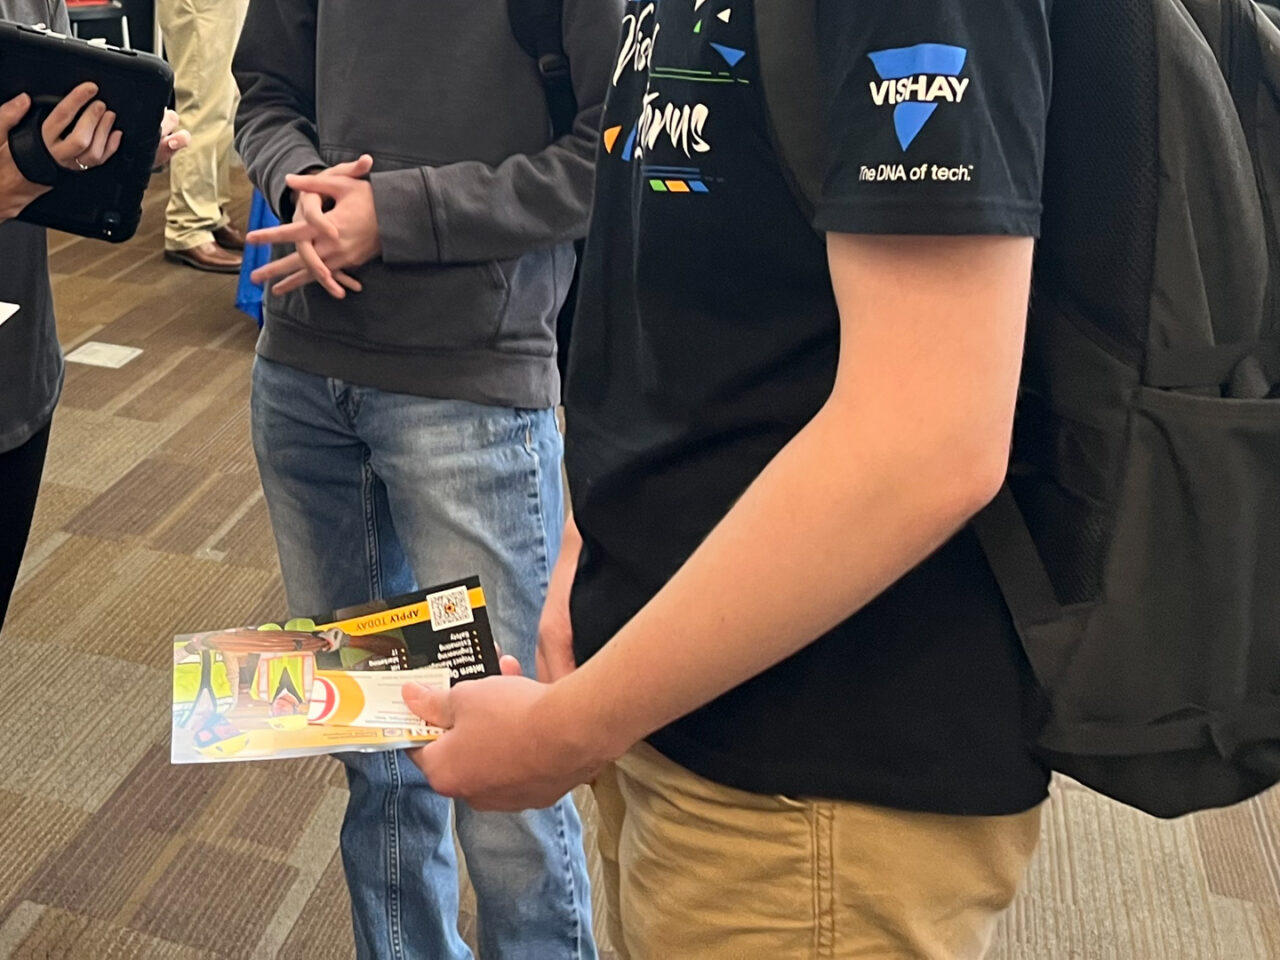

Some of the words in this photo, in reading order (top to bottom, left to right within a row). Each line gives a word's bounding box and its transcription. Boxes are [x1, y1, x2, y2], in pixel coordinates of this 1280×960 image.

[869, 75, 970, 106] VISHAY
[876, 164, 907, 182] DNA
[909, 163, 928, 181] of
[356, 617, 386, 631] TODAY
[390, 608, 419, 624] APPLY
[459, 663, 485, 677] Intern
